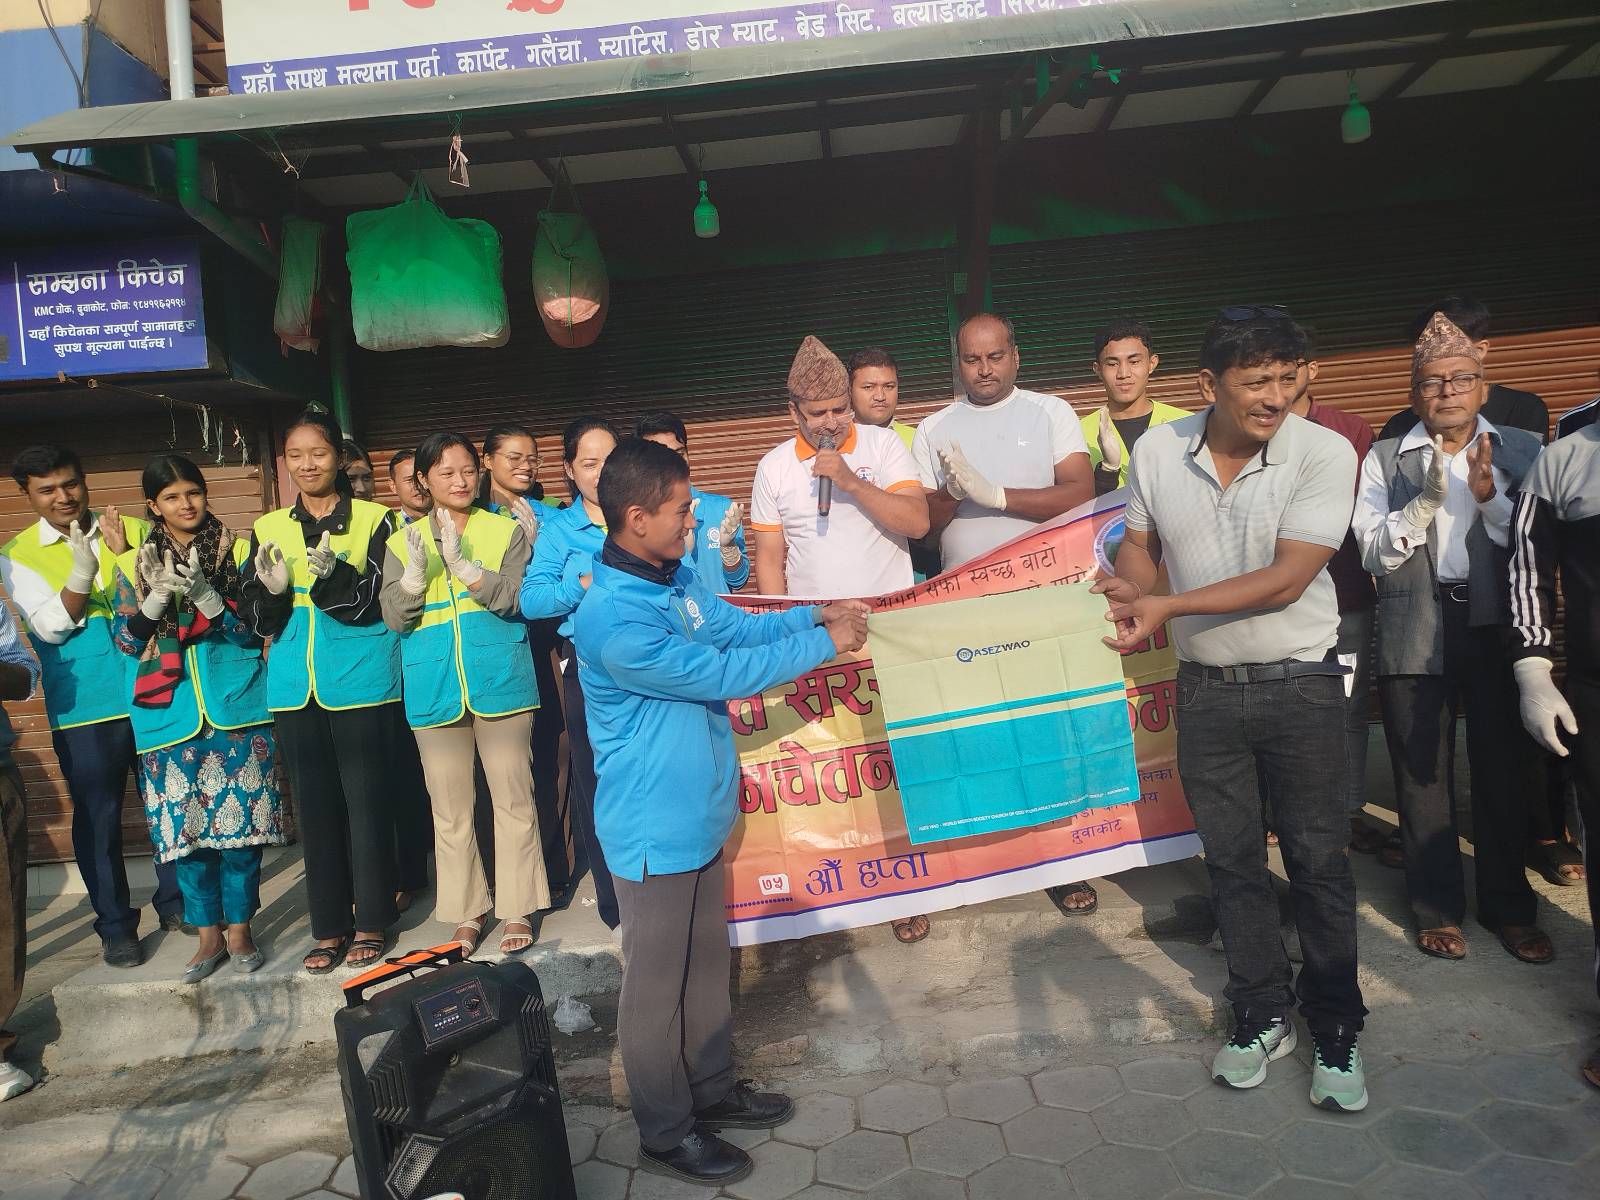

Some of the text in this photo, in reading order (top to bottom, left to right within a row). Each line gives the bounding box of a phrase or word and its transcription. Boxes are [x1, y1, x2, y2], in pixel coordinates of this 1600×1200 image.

[684, 21, 723, 51] डोर
[795, 10, 827, 40] बेड
[835, 3, 881, 35] सिट,
[26, 258, 188, 296] सम्झना किचेन
[34, 305, 55, 317] KMC
[55, 302, 75, 314] चोक,
[76, 300, 109, 316] दुवाकोट,
[110, 299, 131, 311] फोन:
[28, 325, 50, 341] यहाँ
[53, 324, 100, 338] किचेनका
[103, 320, 140, 338] सम्पूर्ण
[54, 342, 83, 357] सुपथ
[86, 340, 125, 356] मूल्यमा
[968, 559, 1016, 585] स्वच्छ
[1020, 542, 1057, 571] बाटो
[1070, 818, 1122, 844] दुवाकोट
[762, 876, 784, 891] ७५
[856, 851, 931, 889] हप्ता
